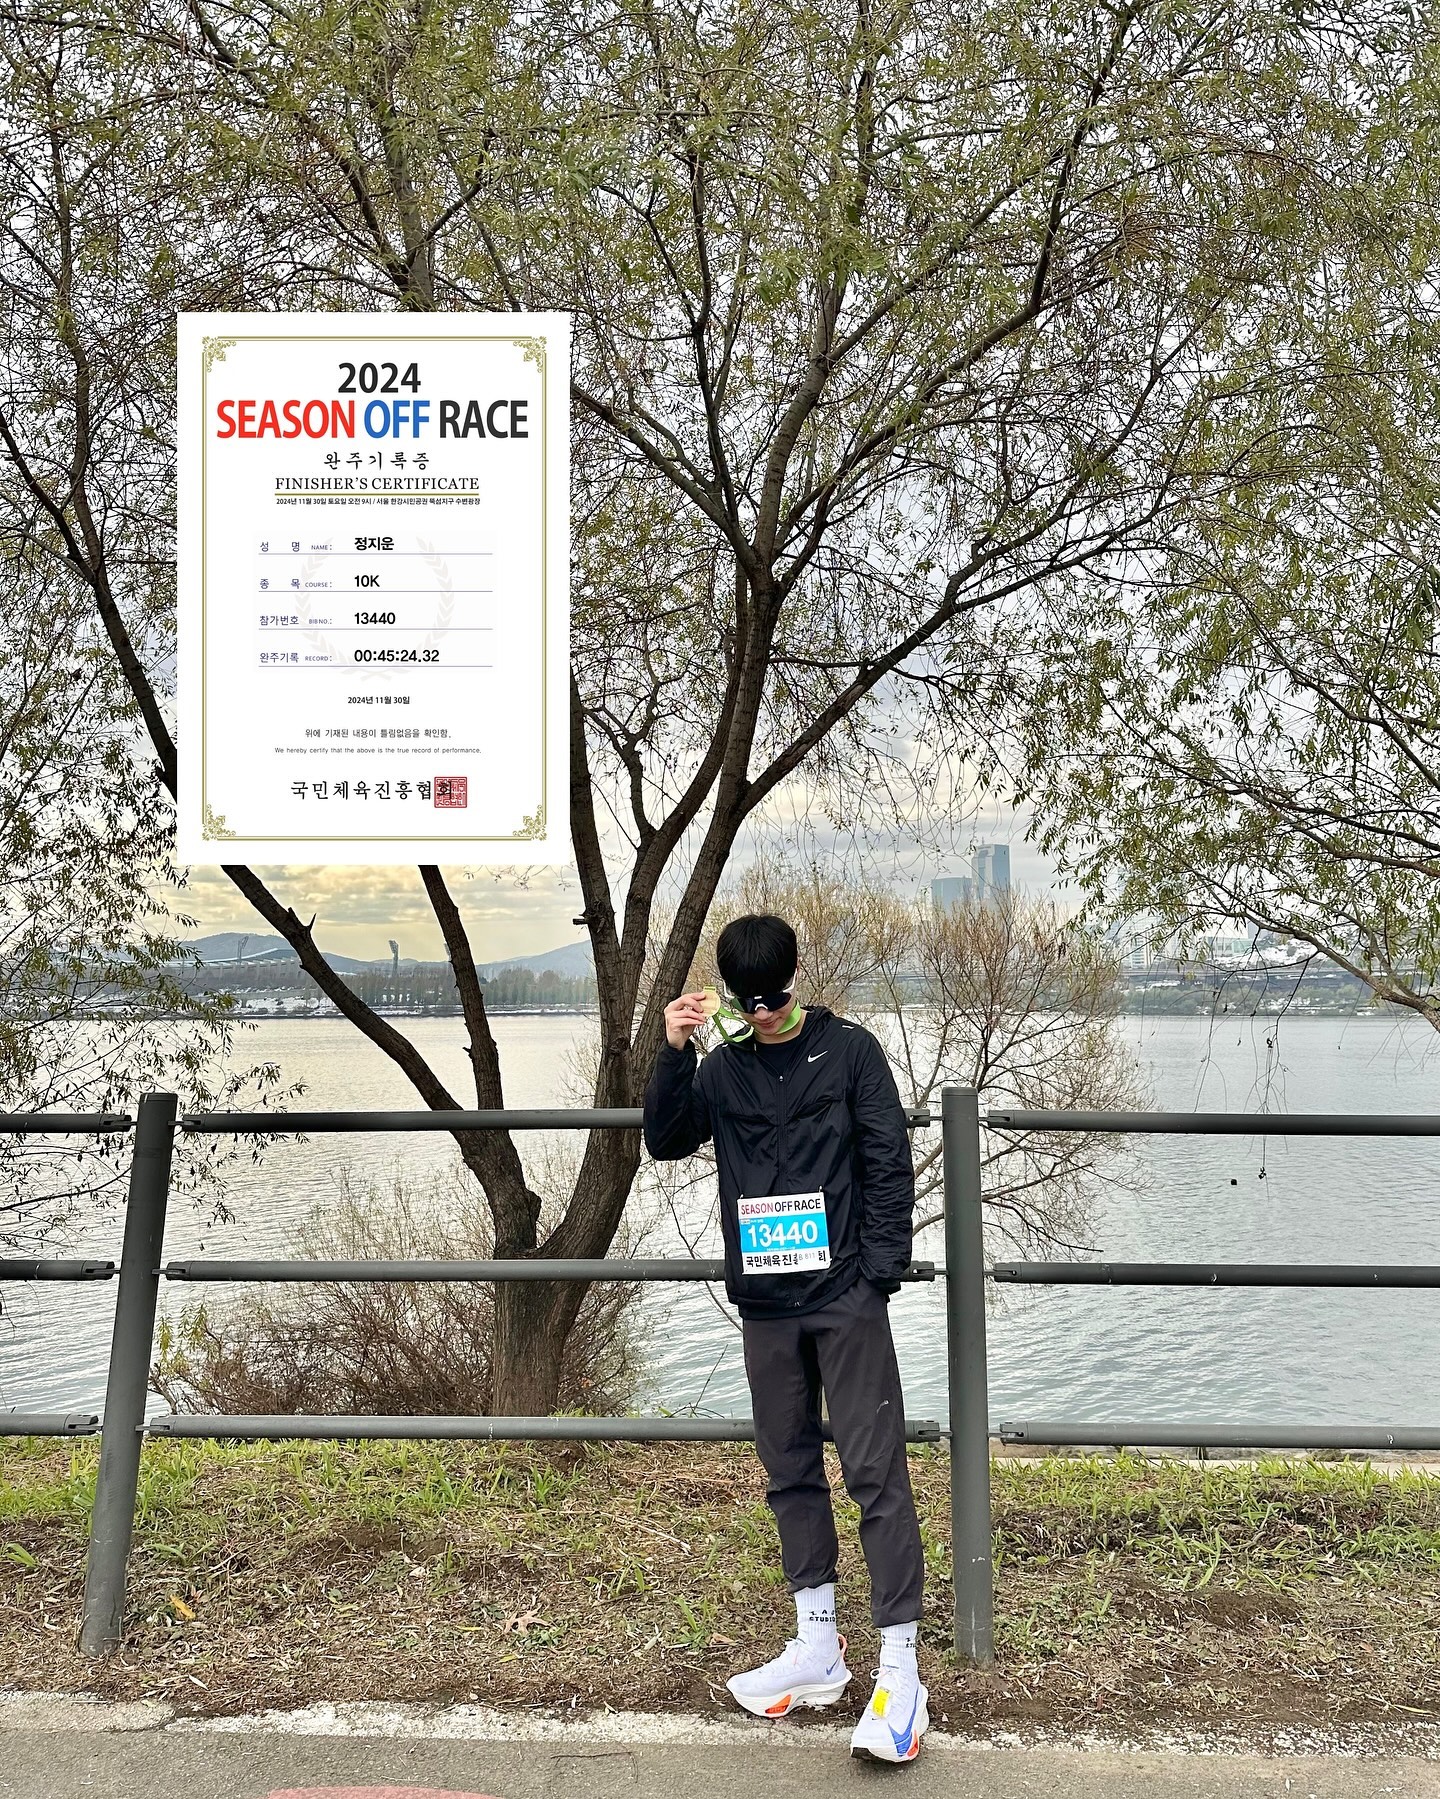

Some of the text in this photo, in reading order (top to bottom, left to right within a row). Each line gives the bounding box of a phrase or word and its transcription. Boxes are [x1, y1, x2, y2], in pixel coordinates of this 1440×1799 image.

[741, 1199, 821, 1215] SEASON OFF RACE
[748, 1220, 818, 1247] 13440
